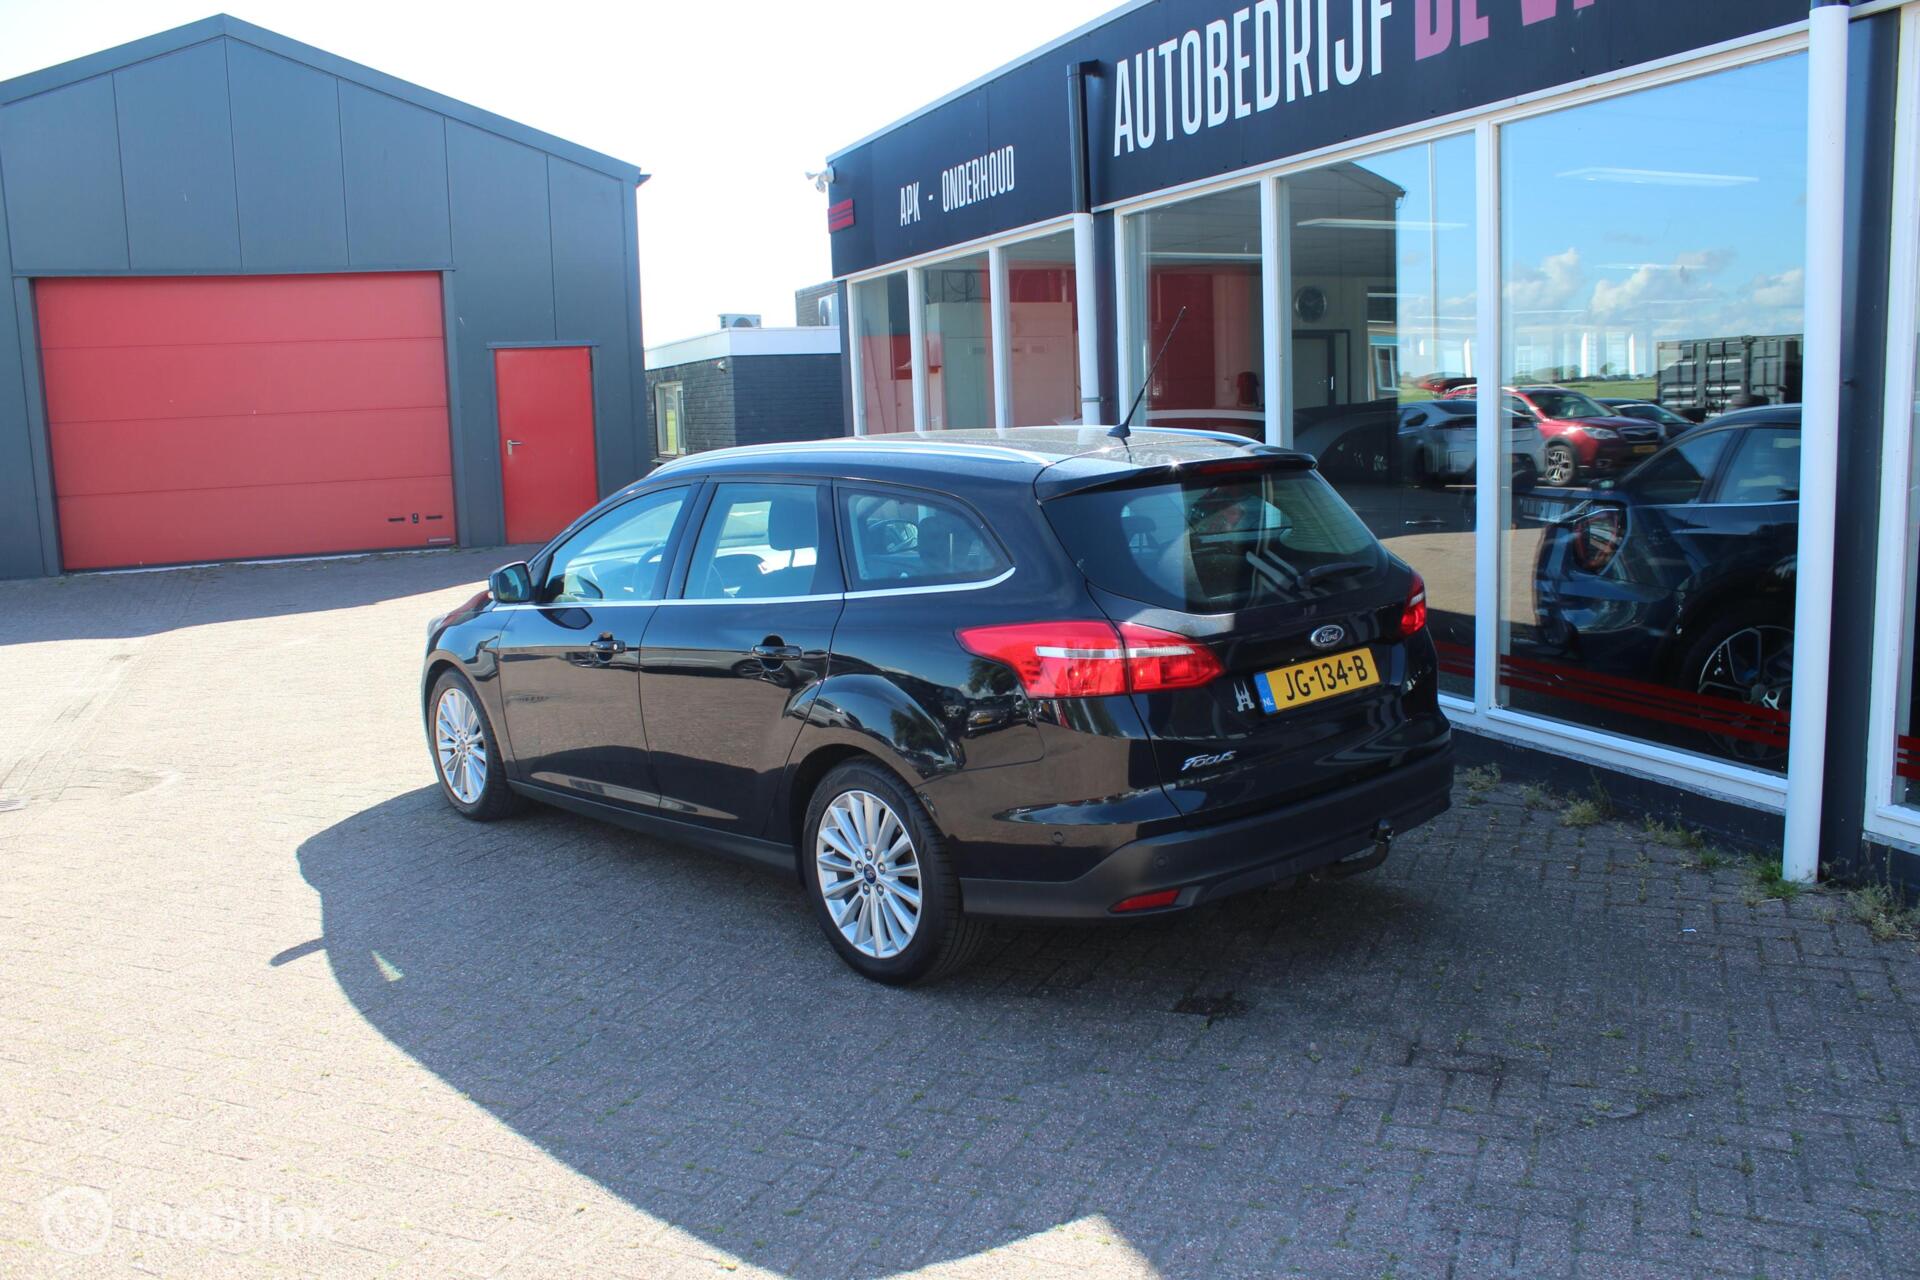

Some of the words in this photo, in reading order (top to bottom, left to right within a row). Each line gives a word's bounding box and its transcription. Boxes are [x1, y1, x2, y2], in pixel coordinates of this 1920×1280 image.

[1113, 0, 1393, 158] AUTOBEDRIJF
[900, 181, 921, 227] APK
[941, 145, 1015, 213] ONDERHOUD
[1262, 698, 1274, 707] NL
[1285, 655, 1368, 701] JG-134-B
